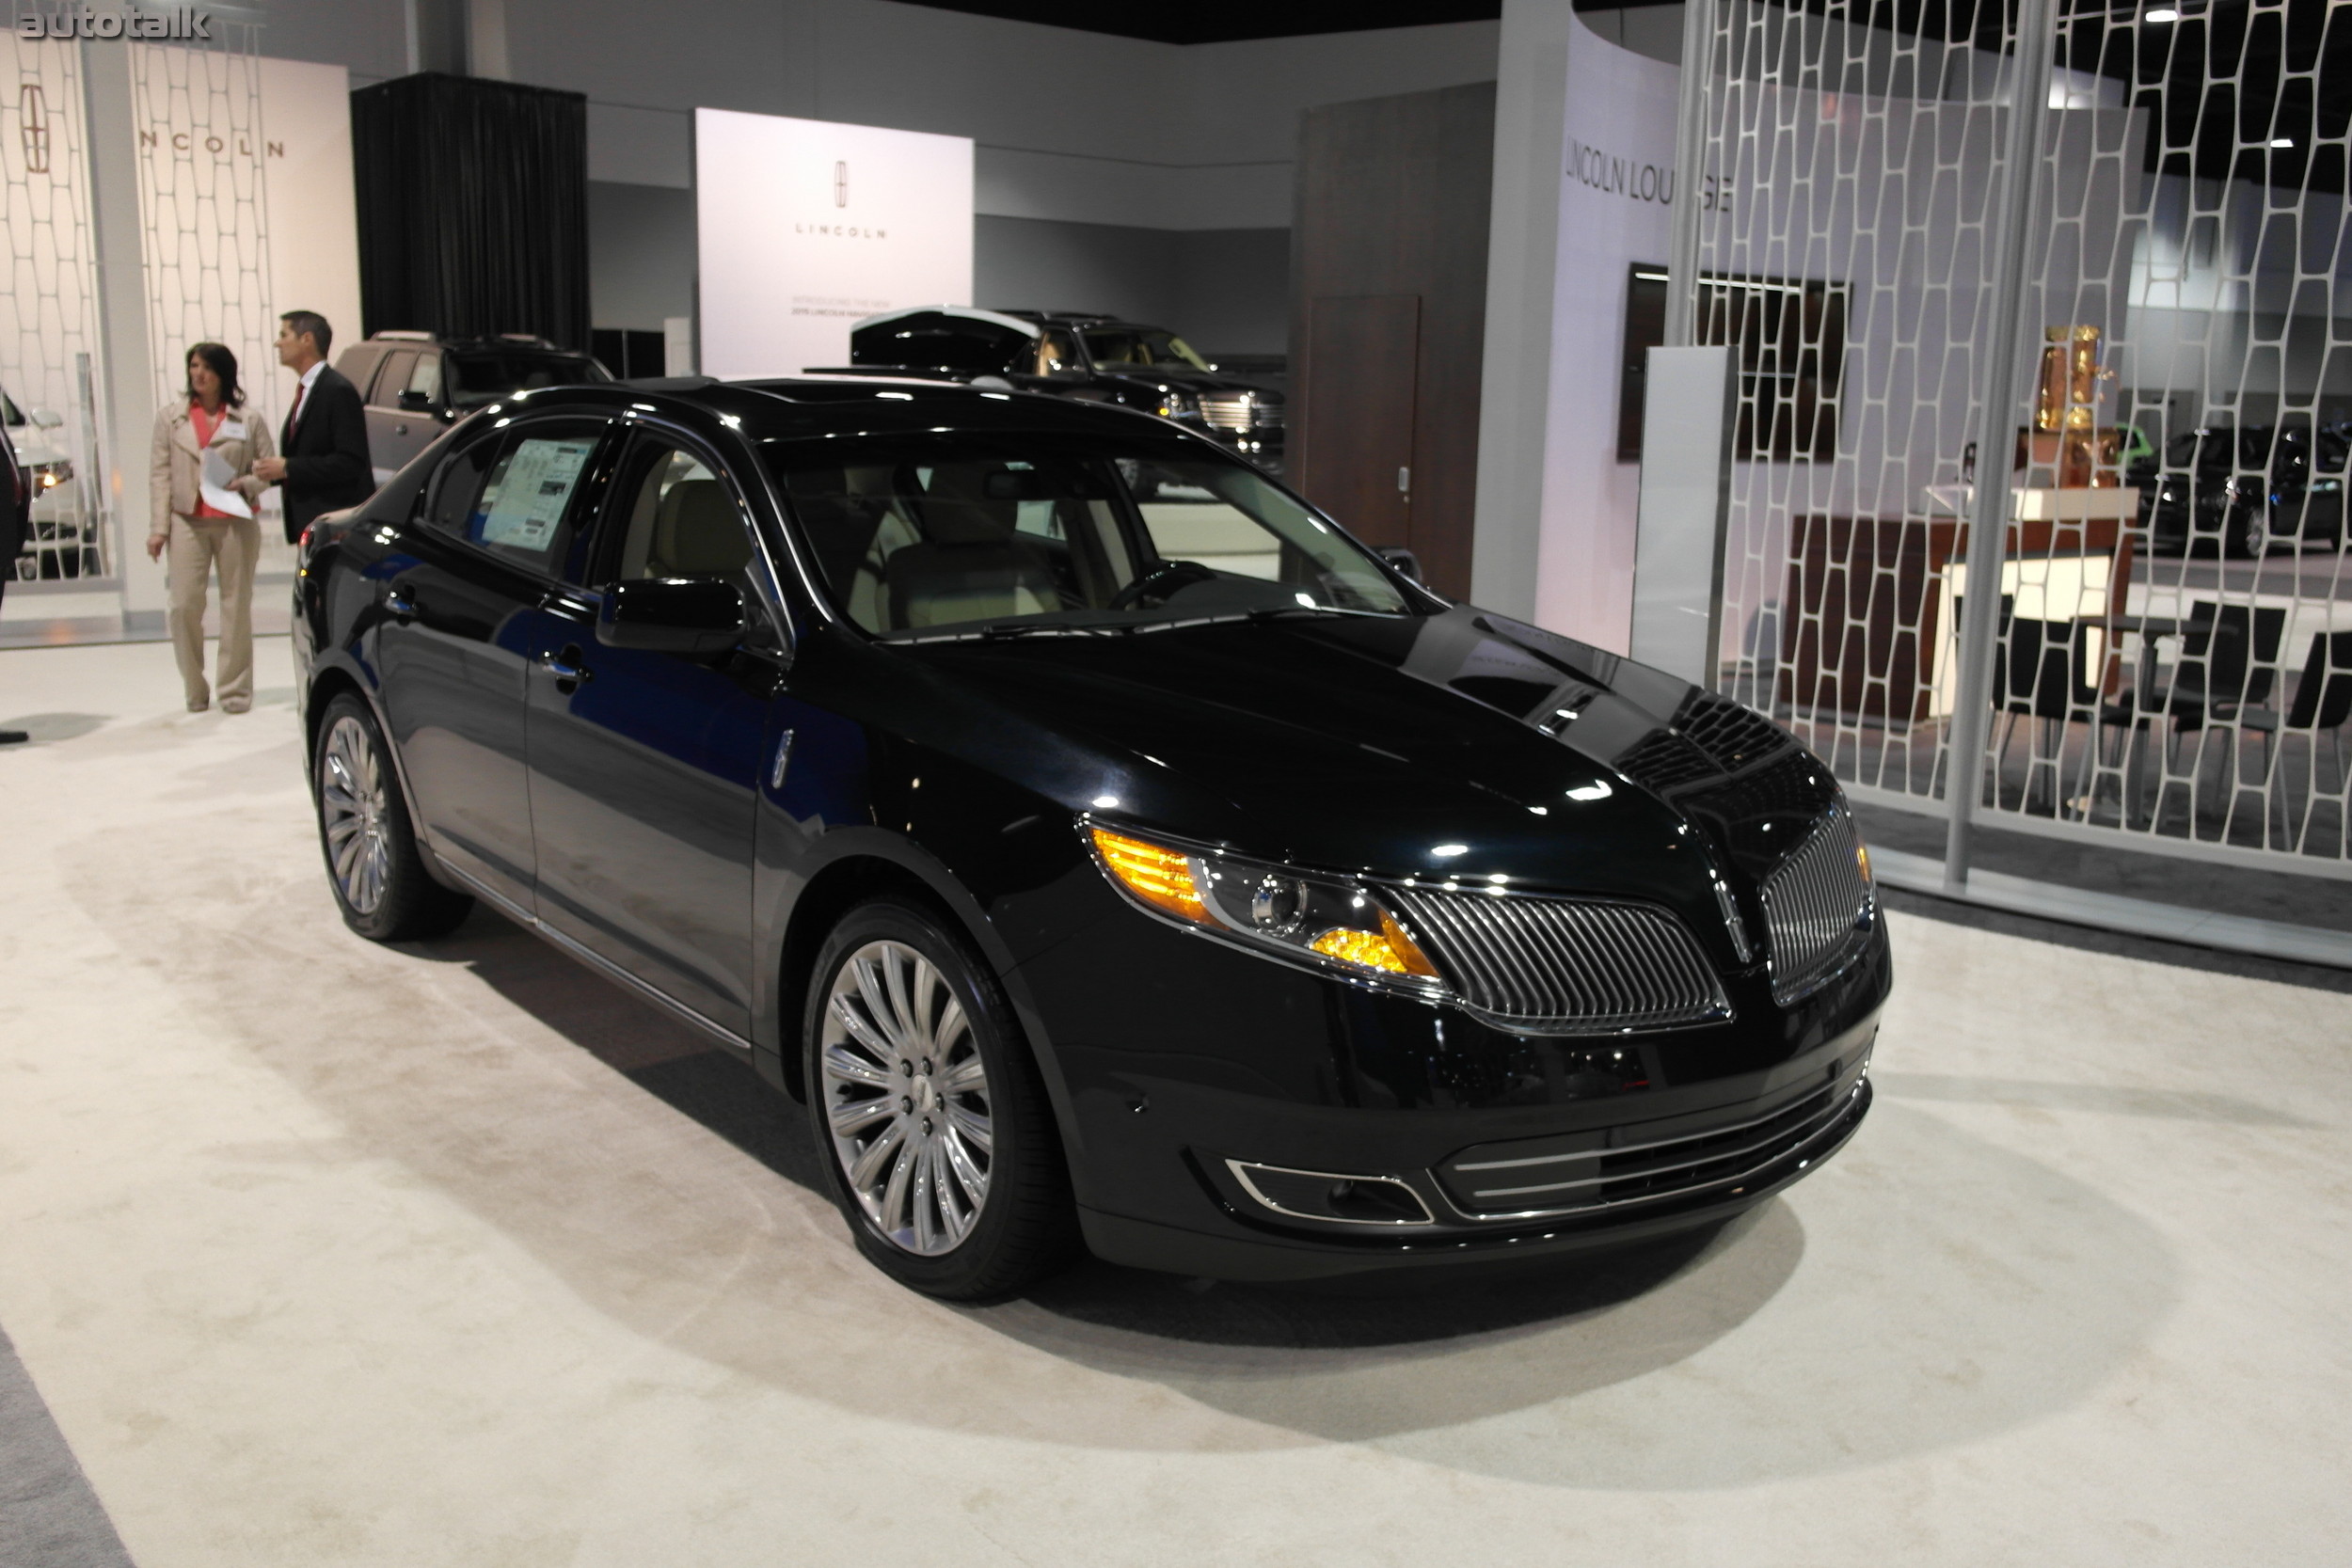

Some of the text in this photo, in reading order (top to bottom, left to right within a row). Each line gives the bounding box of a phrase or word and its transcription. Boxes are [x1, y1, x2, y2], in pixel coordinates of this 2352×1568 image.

[139, 131, 284, 158] NCOLN
[1629, 161, 1732, 213] LOUGE
[795, 222, 886, 239] LINCOLN
